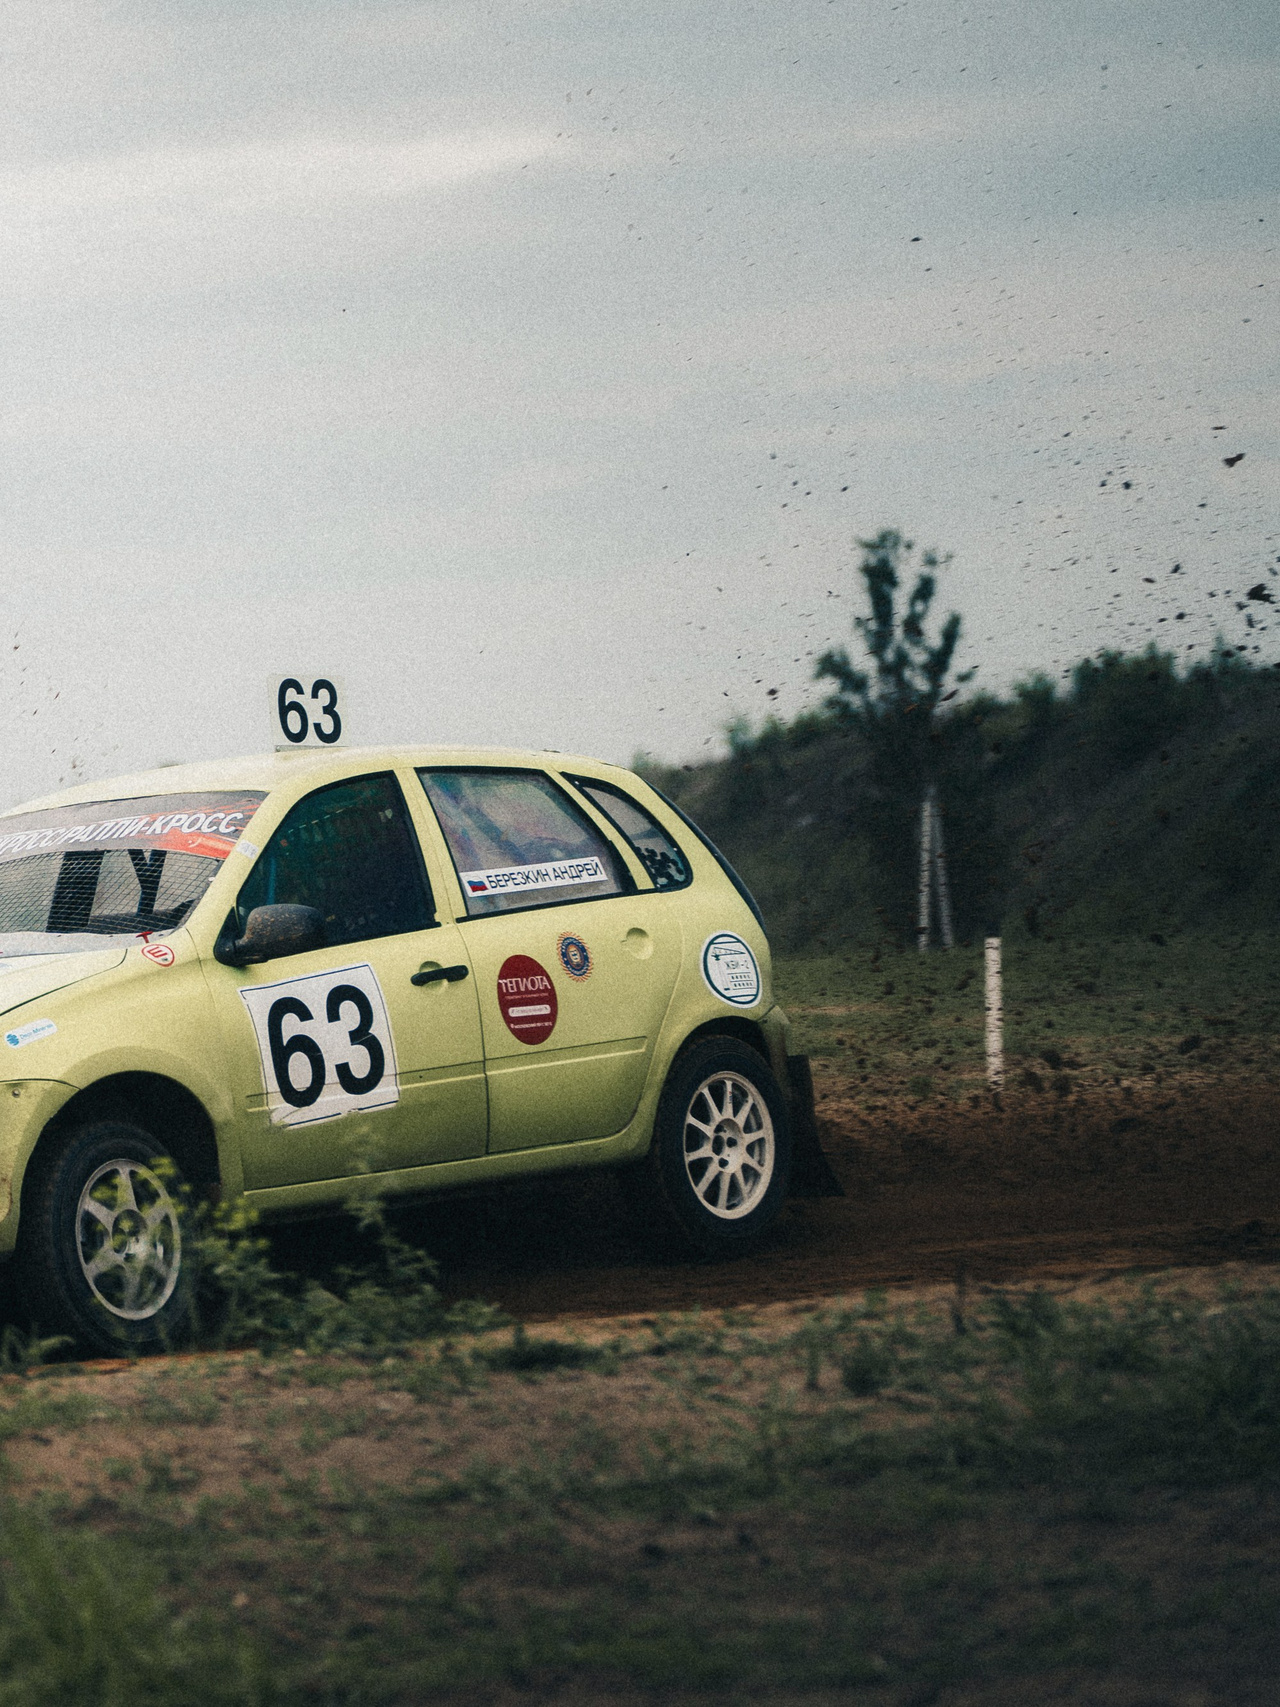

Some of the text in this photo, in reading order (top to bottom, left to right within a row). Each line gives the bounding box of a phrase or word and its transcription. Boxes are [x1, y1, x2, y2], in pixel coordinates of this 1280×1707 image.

[277, 677, 342, 744] 63
[486, 859, 603, 889] БЕРЕЗКИН АНДРЕЙ
[498, 975, 552, 993] ТЕПЛОТА
[267, 984, 385, 1109] 63
